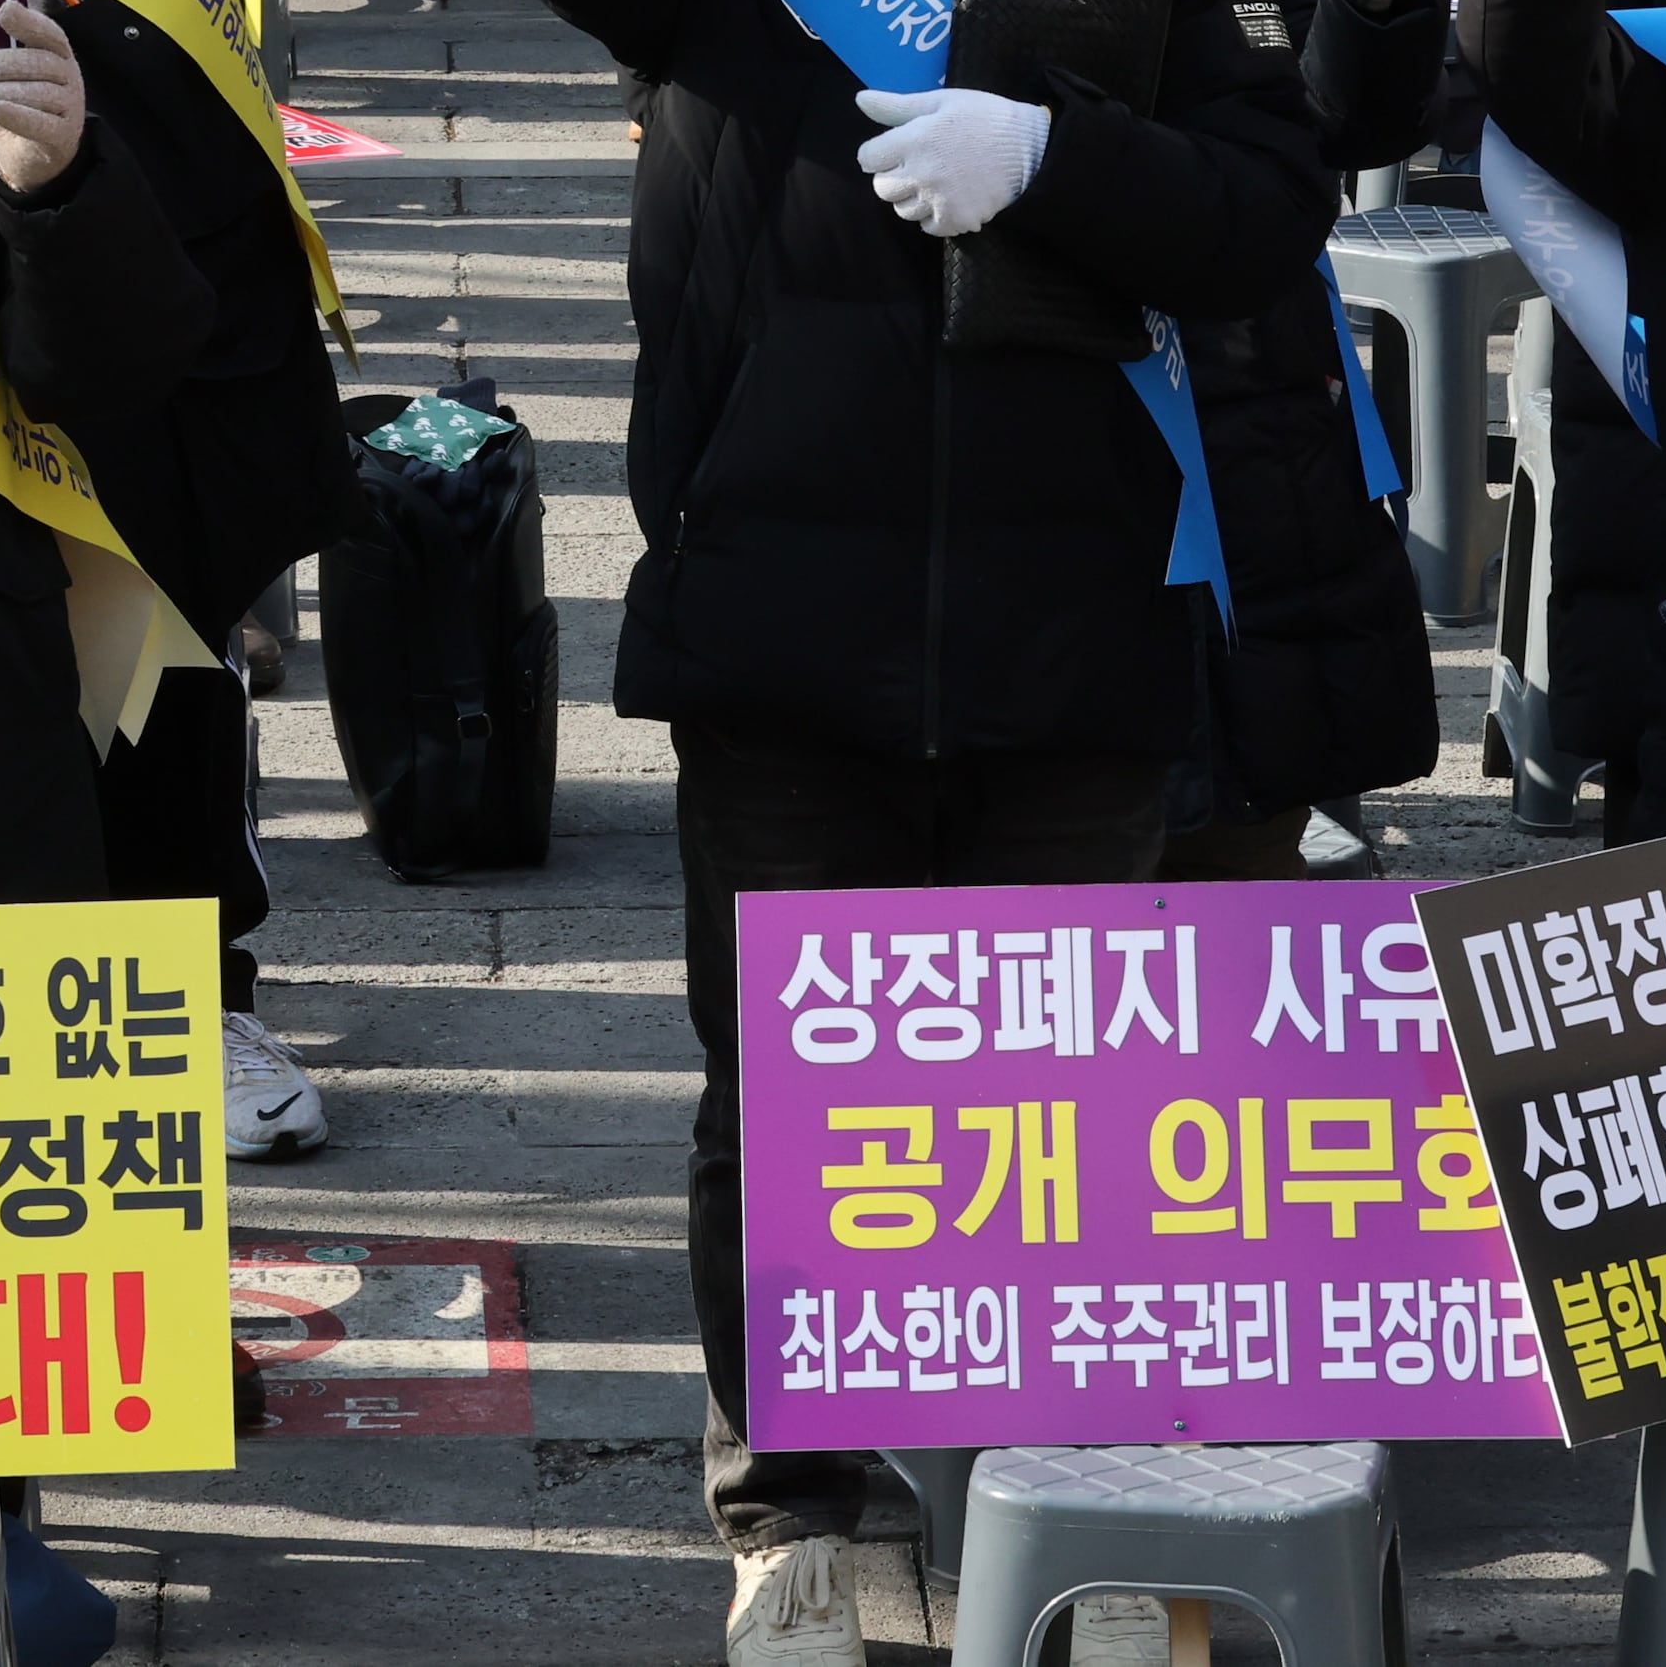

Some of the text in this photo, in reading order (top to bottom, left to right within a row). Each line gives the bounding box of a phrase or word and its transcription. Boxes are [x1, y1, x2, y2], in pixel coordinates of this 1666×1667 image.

[46, 955, 191, 1081] 없는
[778, 922, 1200, 1065] 상장폐지
[820, 1099, 1081, 1251] 공개
[779, 1280, 1291, 1396] 최소한의 주주권리
